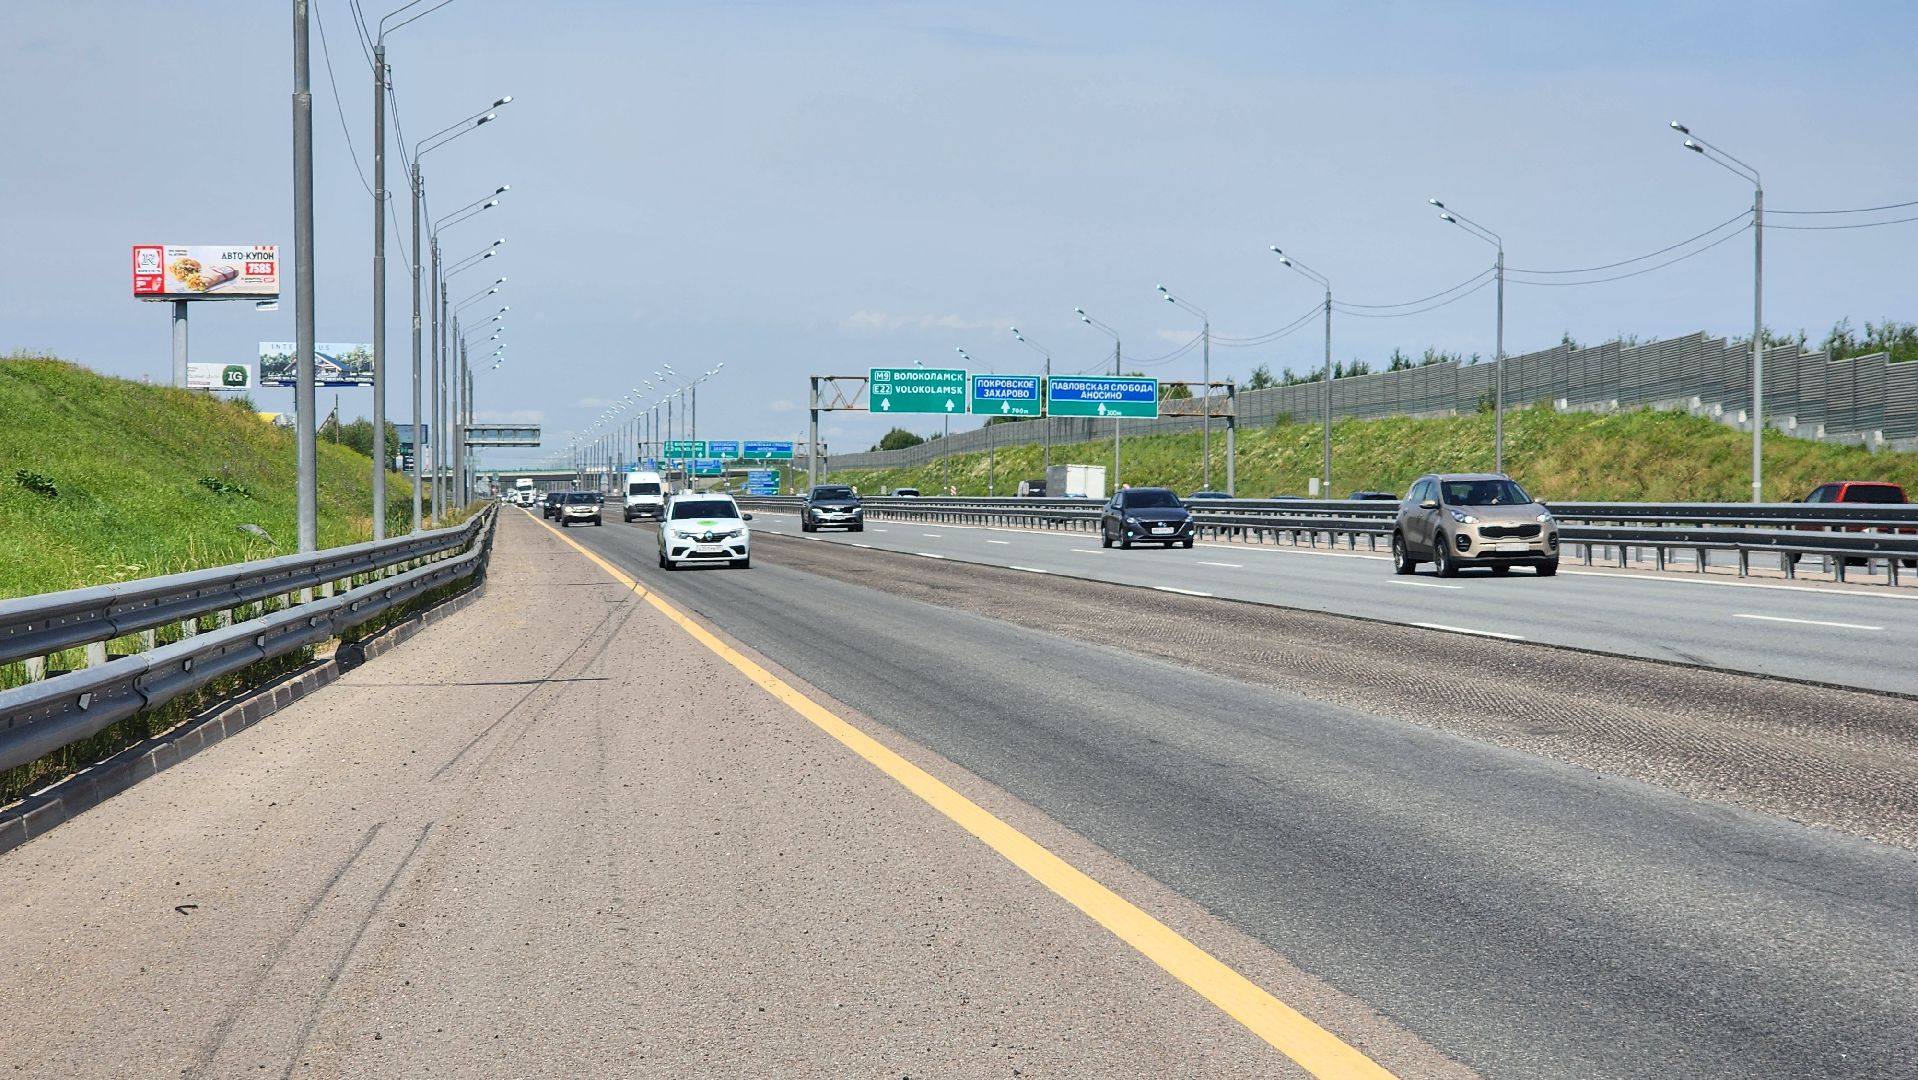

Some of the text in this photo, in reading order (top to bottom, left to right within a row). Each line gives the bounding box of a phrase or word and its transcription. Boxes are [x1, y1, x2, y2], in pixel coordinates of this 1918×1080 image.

[247, 263, 271, 274] 7585
[227, 371, 243, 382] IG
[876, 372, 964, 381] М9 ВОЛОКОЛАМСК
[977, 379, 1035, 388] ПОКРОВСКОЕ
[1051, 382, 1153, 392] ПАВЛОВСКАЯ СЛОБОДА
[874, 385, 963, 394] E22 VOLOKOLAMSK
[983, 389, 1030, 398] ЗАХАРОВО
[1080, 391, 1123, 400] АНОСИНО
